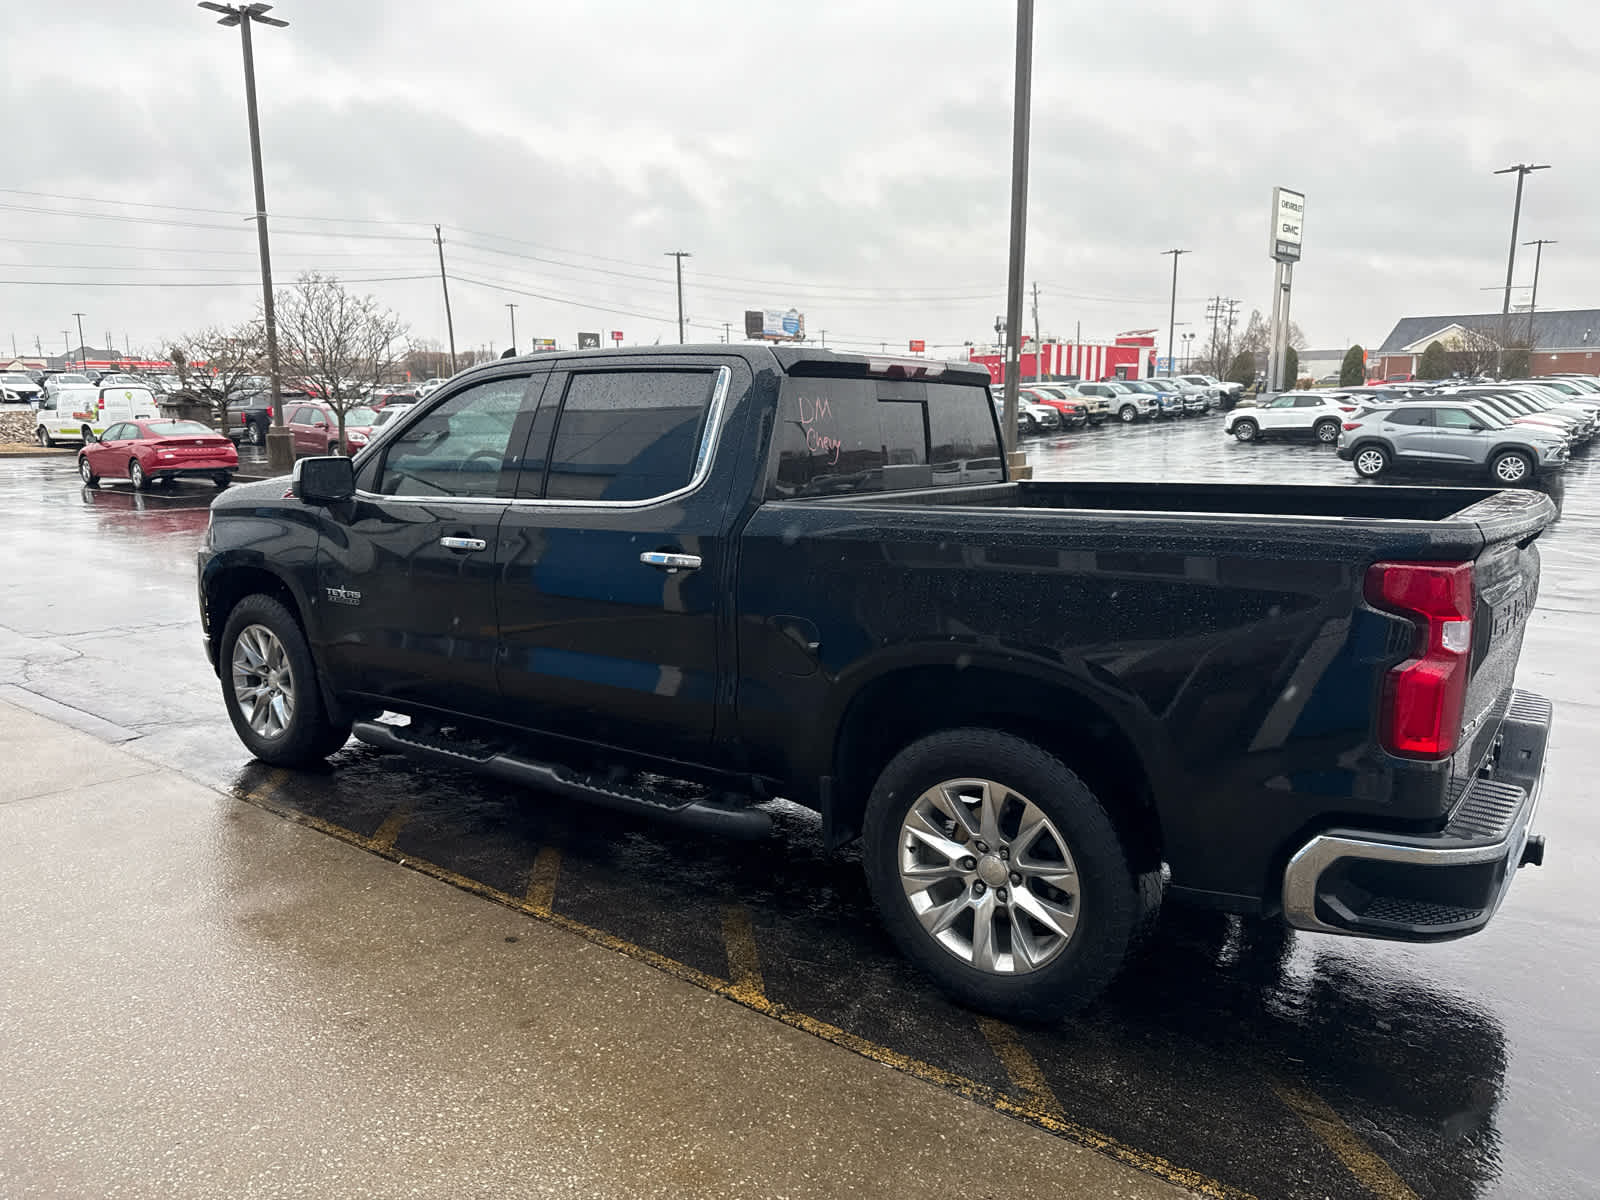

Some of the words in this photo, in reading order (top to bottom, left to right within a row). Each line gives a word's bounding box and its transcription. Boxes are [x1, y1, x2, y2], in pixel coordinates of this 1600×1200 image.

[1282, 223, 1300, 236] GMC
[798, 396, 832, 424] DM
[806, 427, 840, 466] Chevy
[326, 585, 361, 599] TEXAS
